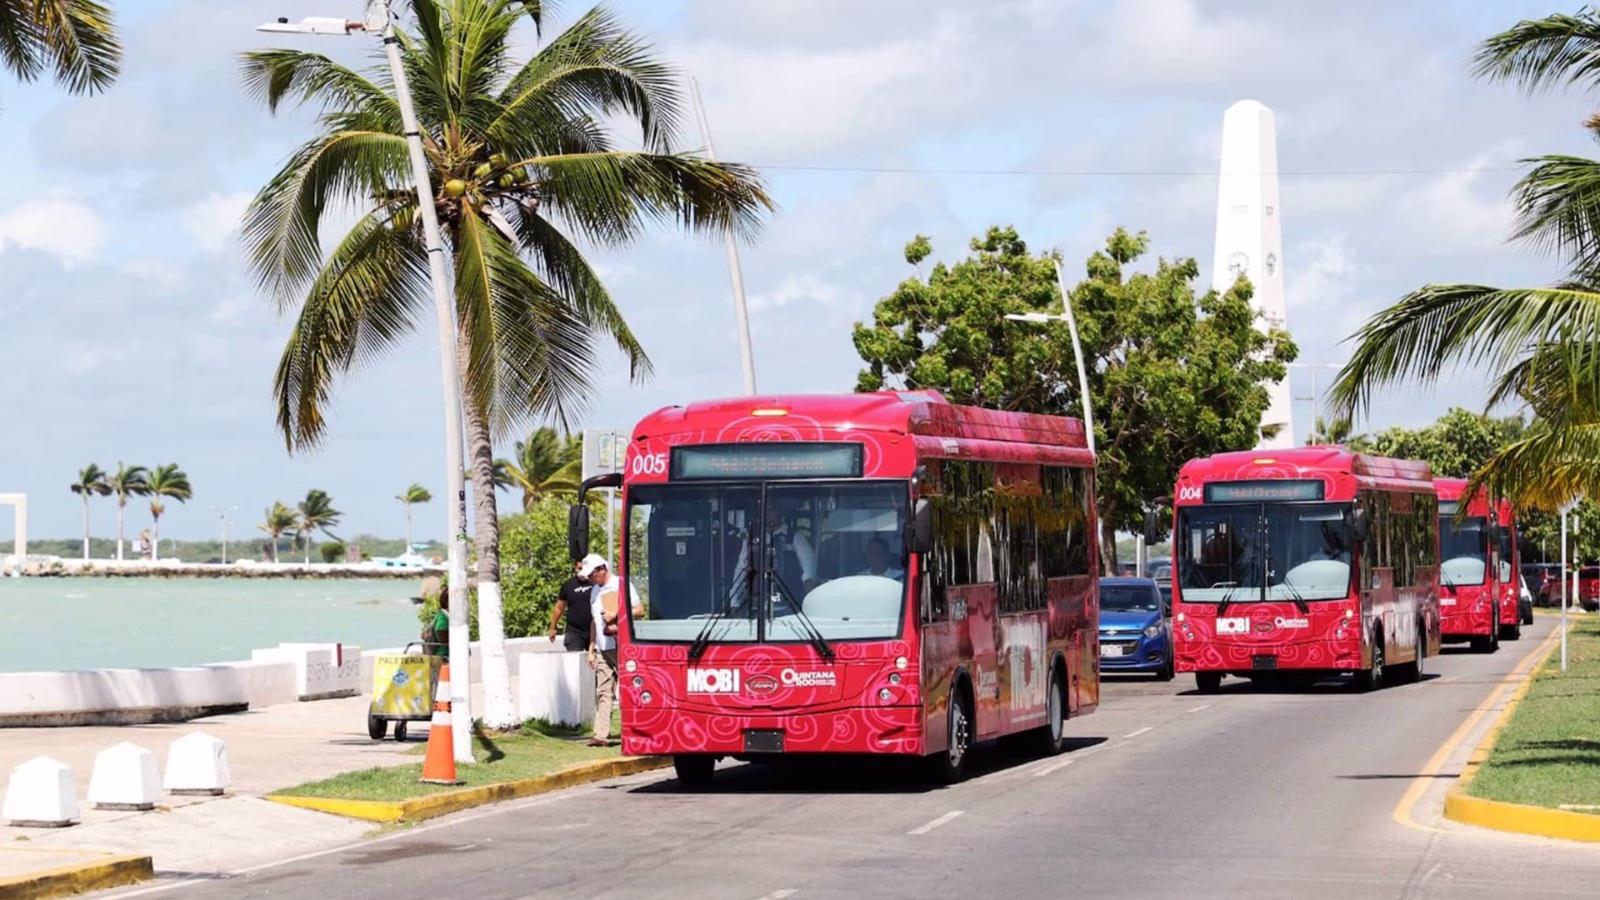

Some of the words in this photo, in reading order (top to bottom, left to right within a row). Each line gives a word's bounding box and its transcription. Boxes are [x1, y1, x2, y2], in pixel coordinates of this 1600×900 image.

[632, 454, 665, 474] 005
[1179, 487, 1201, 500] 004
[1216, 617, 1250, 633] MOBI
[687, 668, 740, 693] MOBI
[780, 668, 836, 684] QUINTANA
